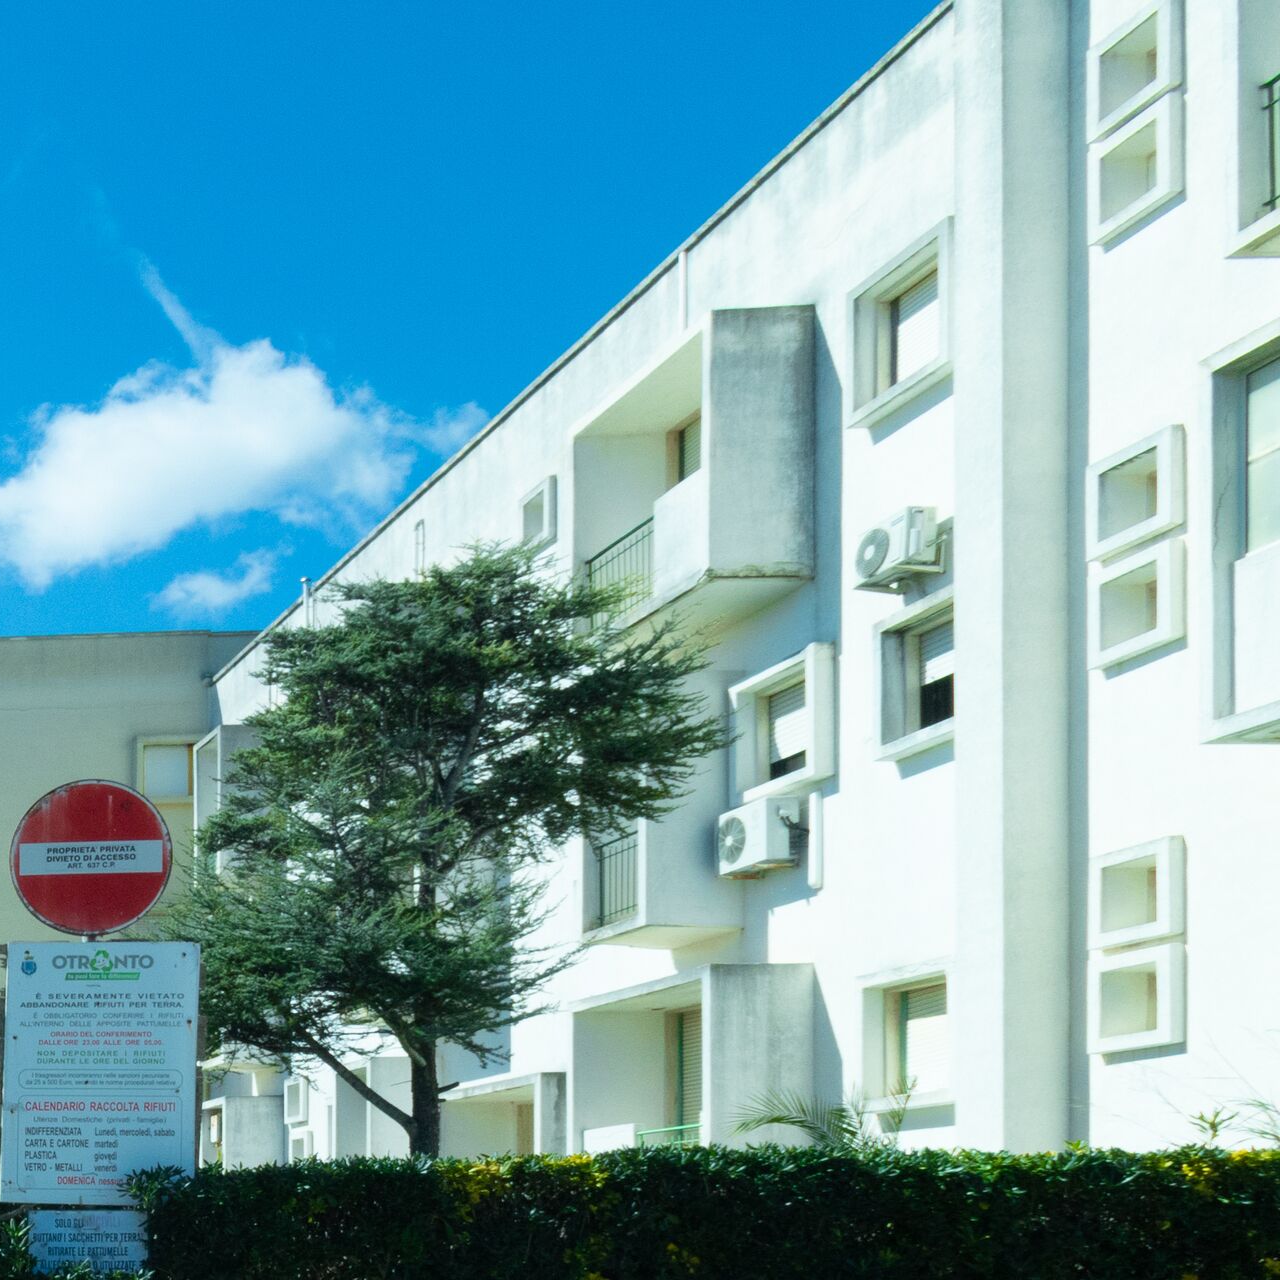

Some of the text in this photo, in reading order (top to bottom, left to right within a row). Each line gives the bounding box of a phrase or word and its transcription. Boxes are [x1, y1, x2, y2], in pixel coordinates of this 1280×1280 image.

[25, 1102, 176, 1112] CALENDARIO RACCOLTA RIFIUTI
[25, 1128, 82, 1136] INDIFFERENZIATA
[25, 1139, 47, 1148] CARTA
[50, 1139, 54, 1148] E
[56, 1139, 88, 1148] CARTONE
[25, 1152, 56, 1160] PLASTICA
[25, 1163, 47, 1172] VETRO
[56, 1163, 82, 1172] METALLI
[58, 1176, 96, 1184] DOMENICA
[55, 1218, 72, 1228] SOLO
[68, 1232, 104, 1241] SACCHETTI
[48, 1246, 76, 1256] RITIRATE
[78, 1246, 86, 1256] LE
